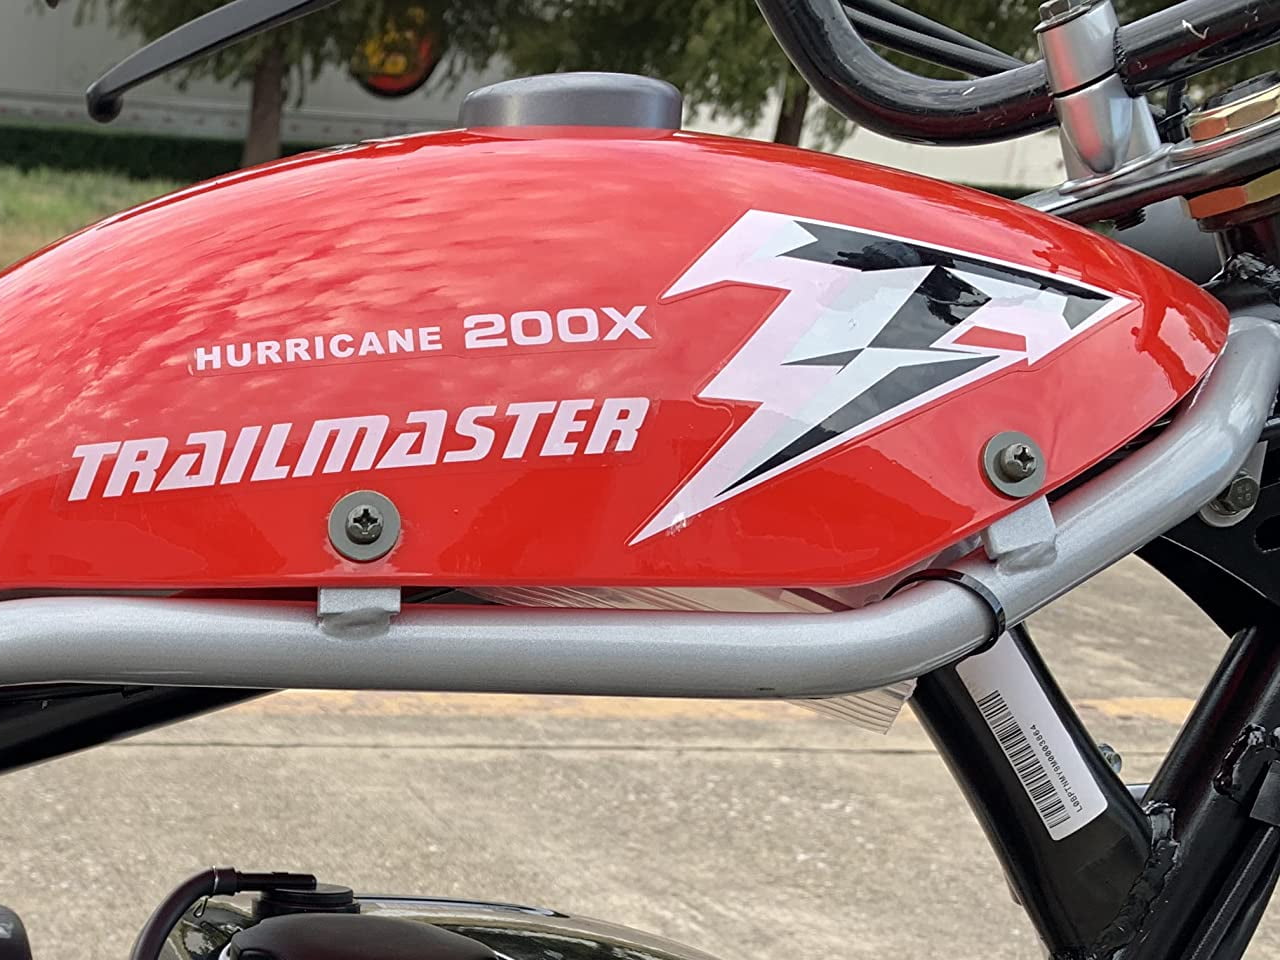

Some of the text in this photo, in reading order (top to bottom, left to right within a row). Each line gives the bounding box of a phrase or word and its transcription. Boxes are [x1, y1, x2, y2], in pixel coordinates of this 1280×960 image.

[196, 304, 652, 372] HURRICANE 200X
[68, 396, 649, 502] TRAILMASTER
